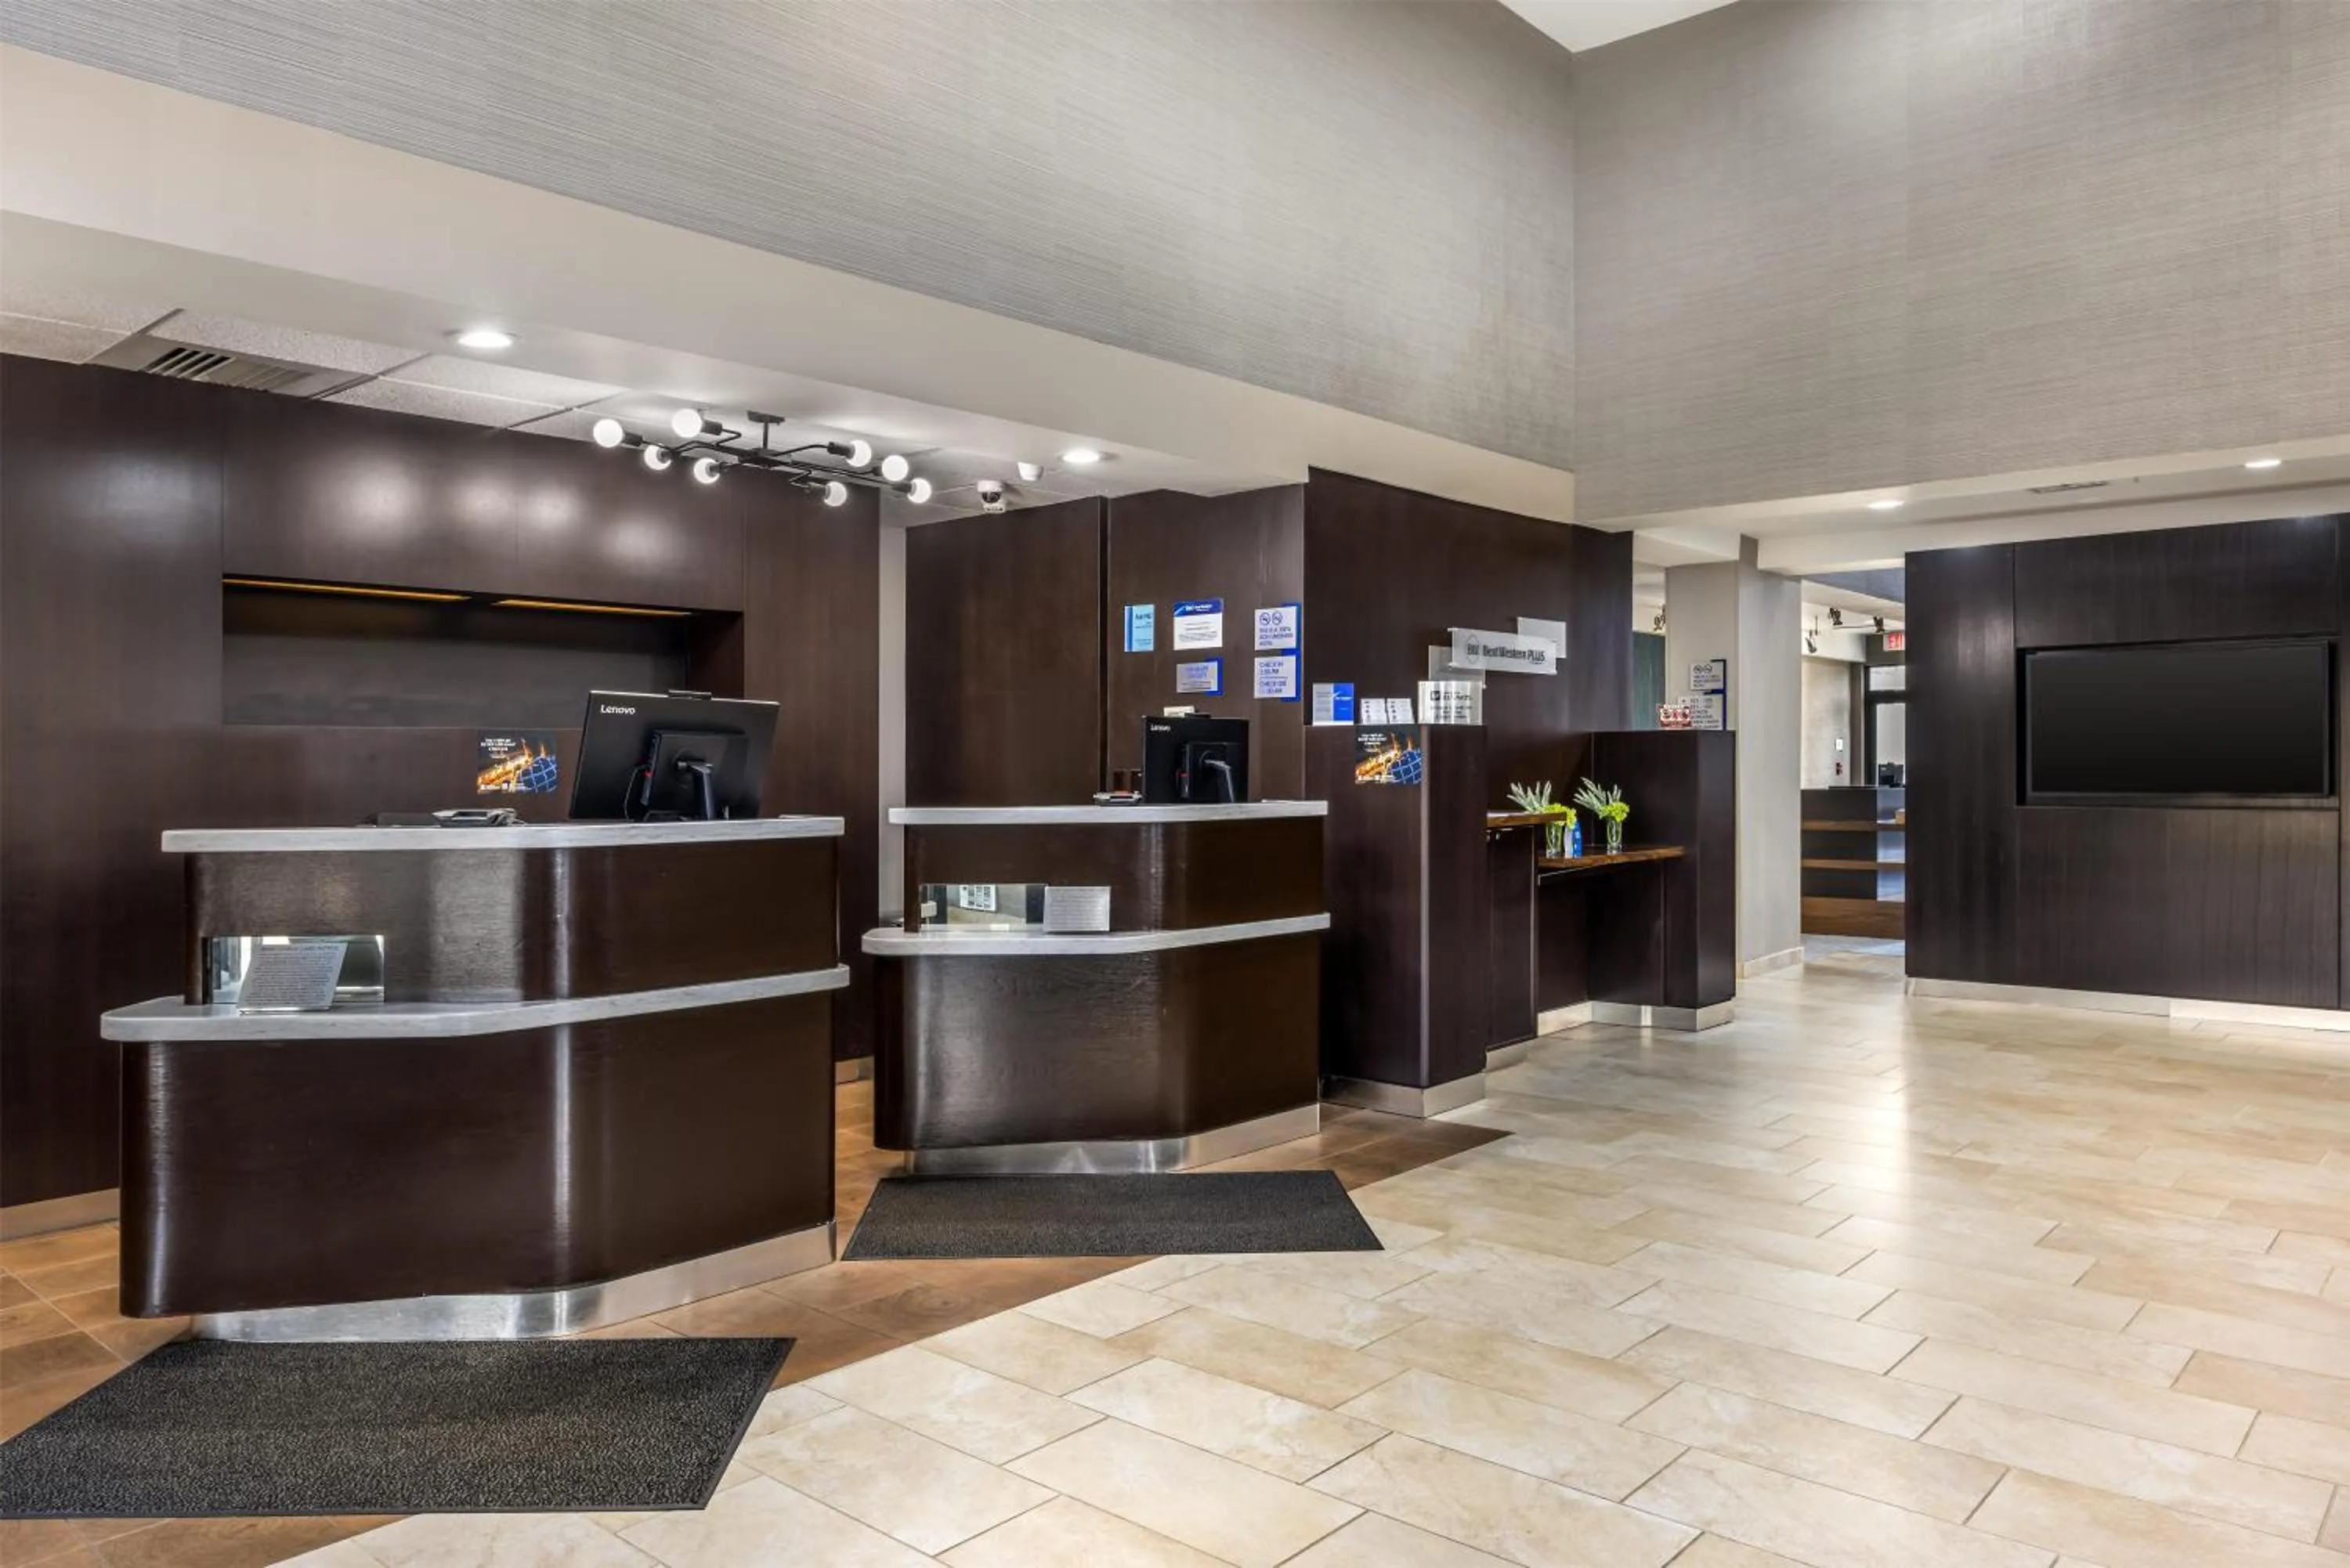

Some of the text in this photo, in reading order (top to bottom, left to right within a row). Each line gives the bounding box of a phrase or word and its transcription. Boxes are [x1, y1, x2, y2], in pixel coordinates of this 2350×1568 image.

[1888, 633, 1903, 649] EXI
[1483, 645, 1498, 656] Best
[1499, 646, 1526, 659] Western
[1527, 649, 1546, 662] PLUS
[601, 704, 635, 715] Lenovo
